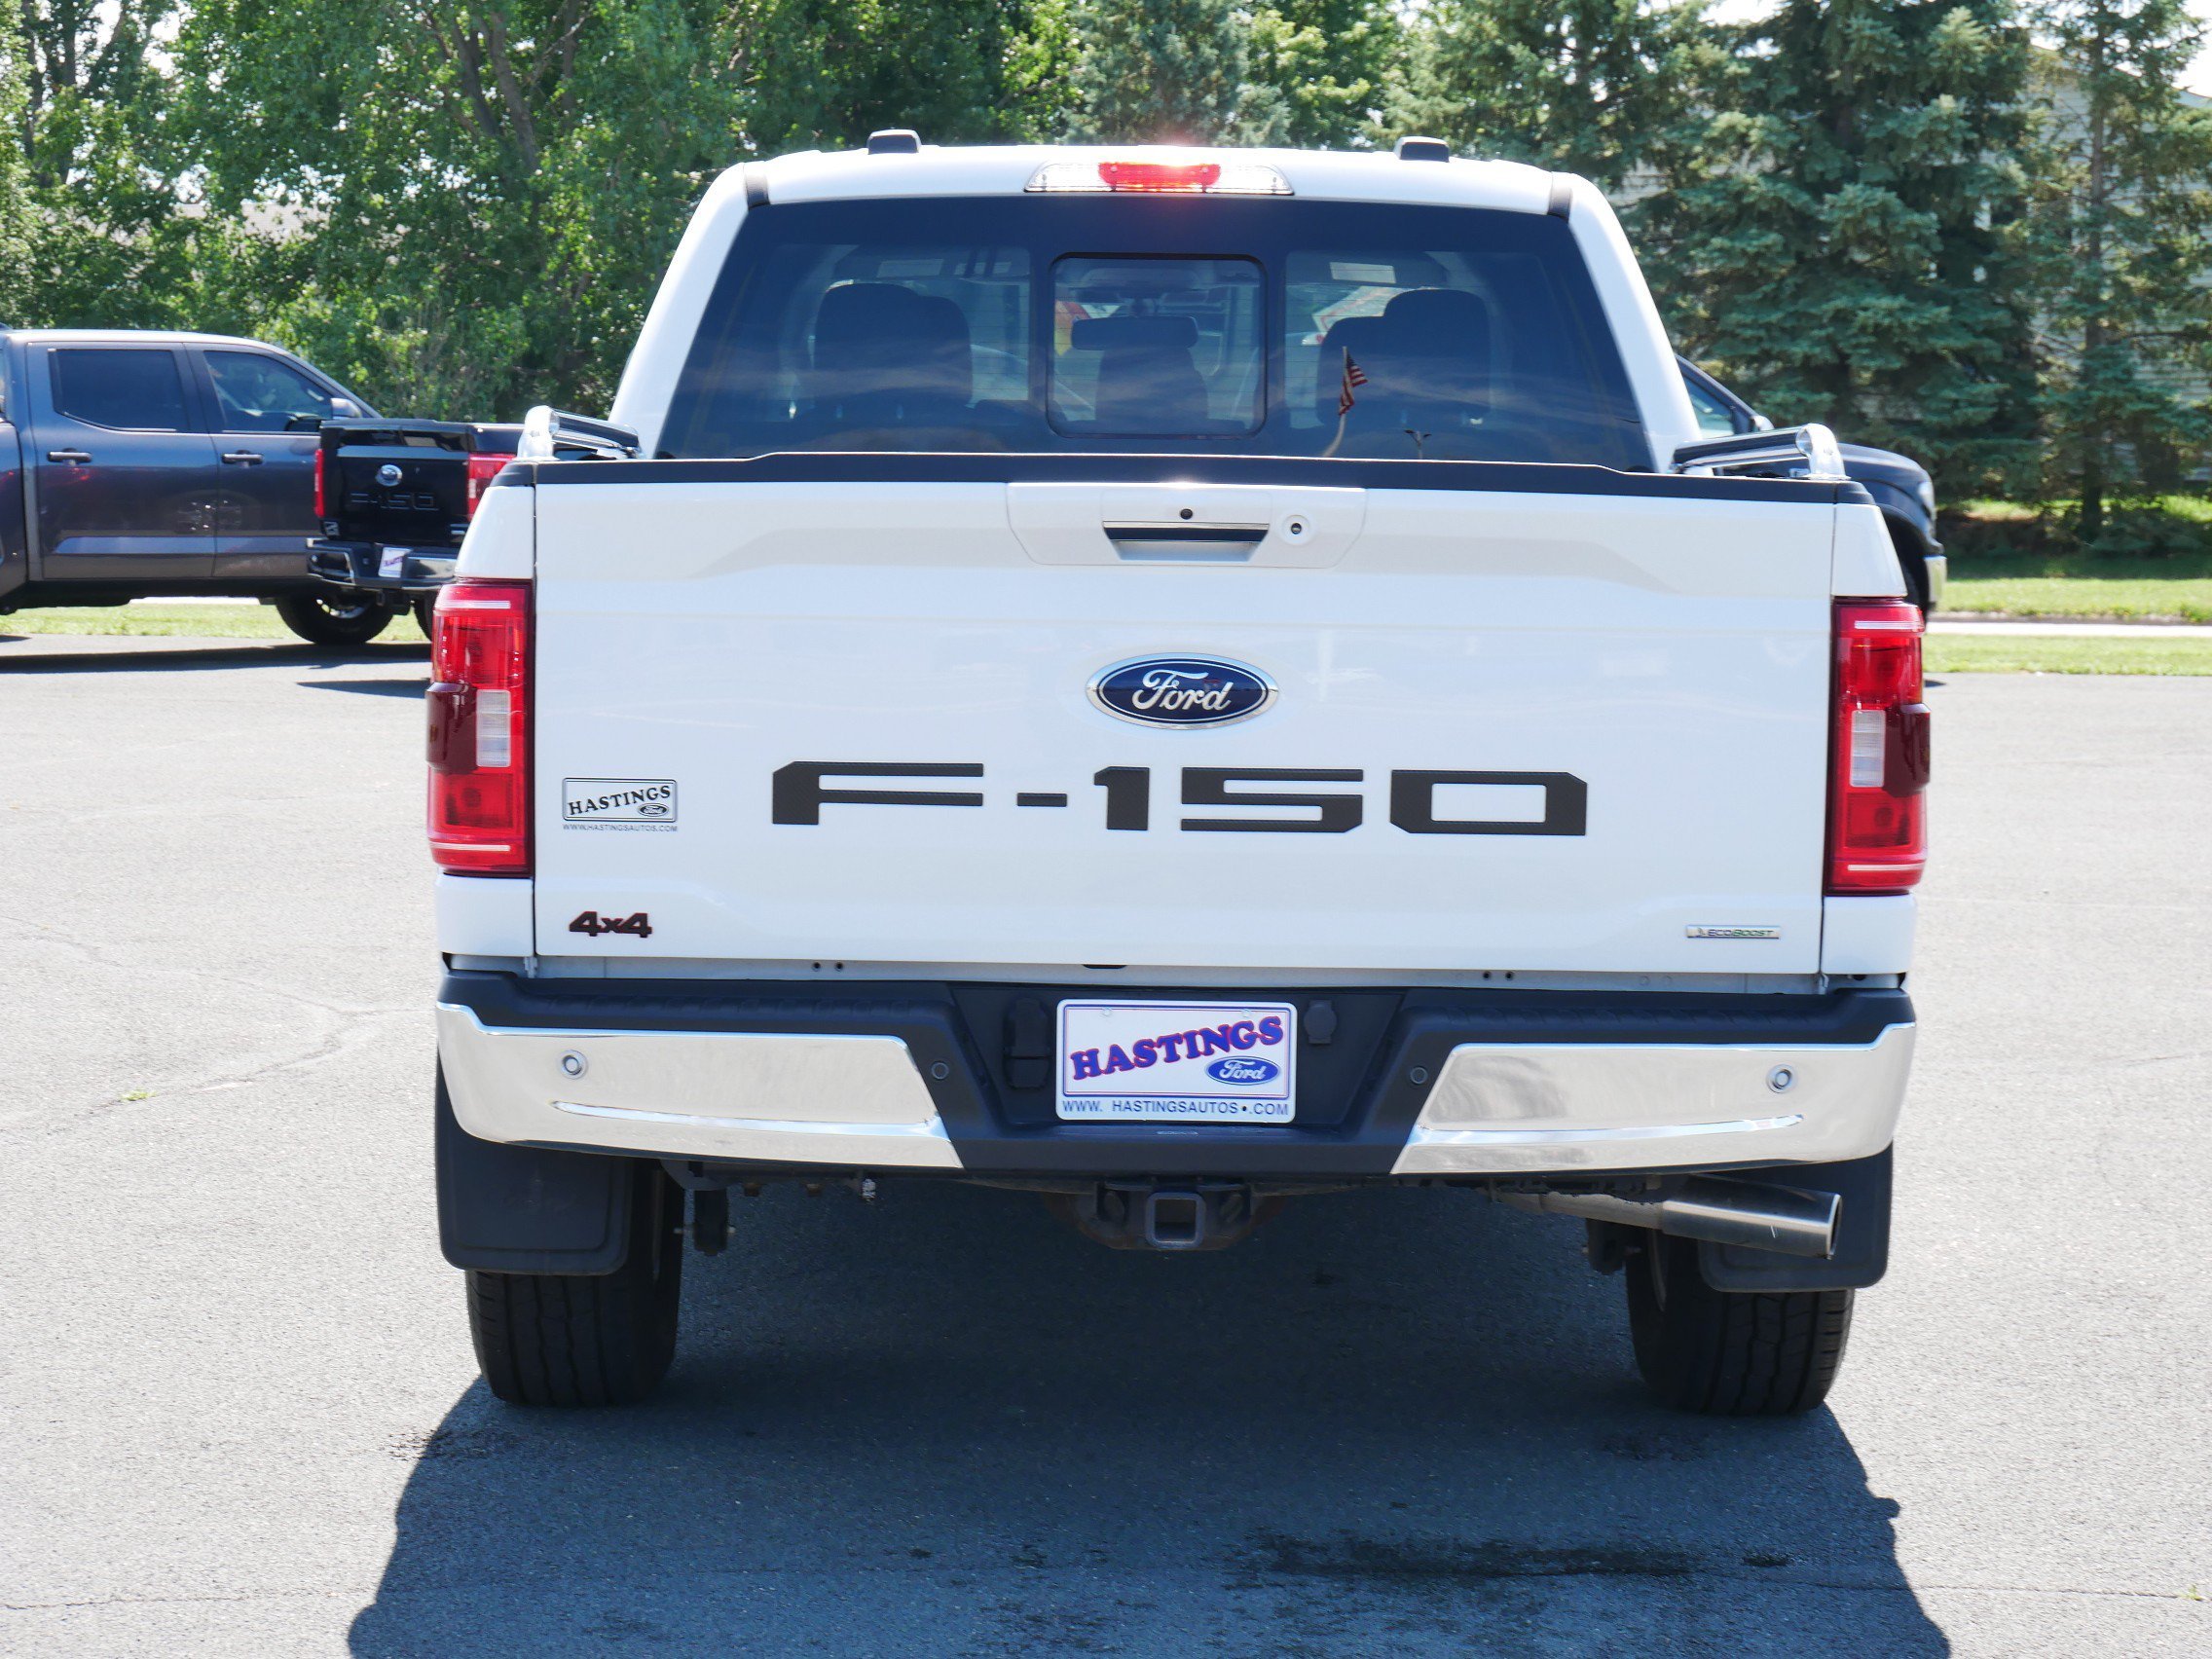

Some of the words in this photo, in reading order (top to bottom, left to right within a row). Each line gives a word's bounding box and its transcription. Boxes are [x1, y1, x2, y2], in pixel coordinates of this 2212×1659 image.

[1131, 669, 1235, 711] Ford
[568, 785, 671, 816] HASTINGS
[772, 760, 1587, 836] F-150
[569, 910, 653, 939] 4x4
[1070, 1015, 1284, 1081] HASTINGS
[1218, 1059, 1268, 1081] Ford
[1062, 1099, 1103, 1113] WWW.
